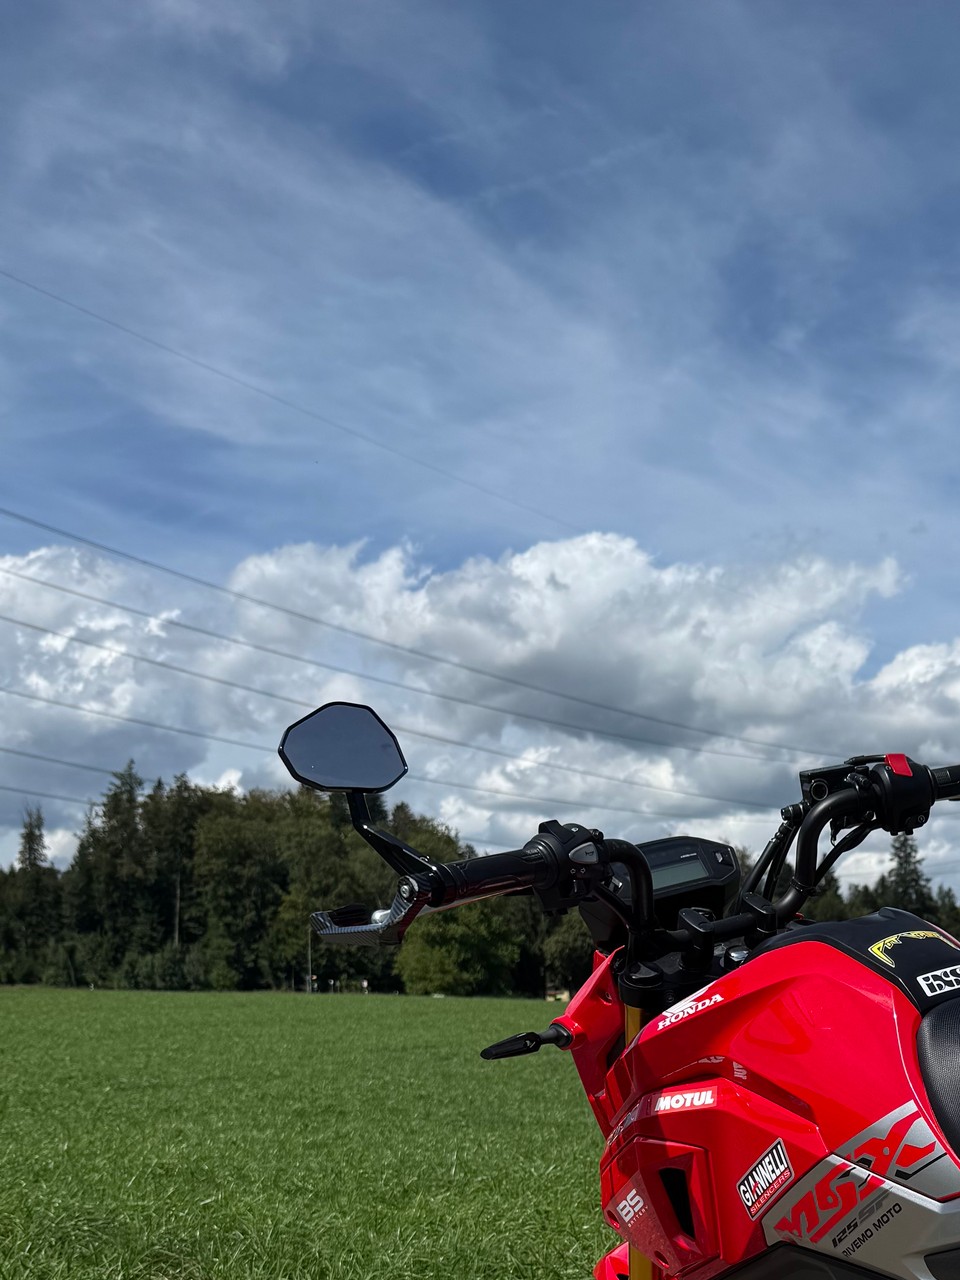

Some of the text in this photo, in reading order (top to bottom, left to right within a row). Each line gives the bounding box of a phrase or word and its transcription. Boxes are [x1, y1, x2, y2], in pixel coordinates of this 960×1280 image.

[656, 993, 724, 1031] HONDA
[655, 1090, 714, 1112] MOTUL
[740, 1144, 788, 1207] GIANNELLI
[750, 1168, 791, 1214] SILENCERS
[616, 1188, 644, 1223] BS
[831, 1217, 859, 1248] 125
[842, 1202, 903, 1258] RIVEMO MOTO
